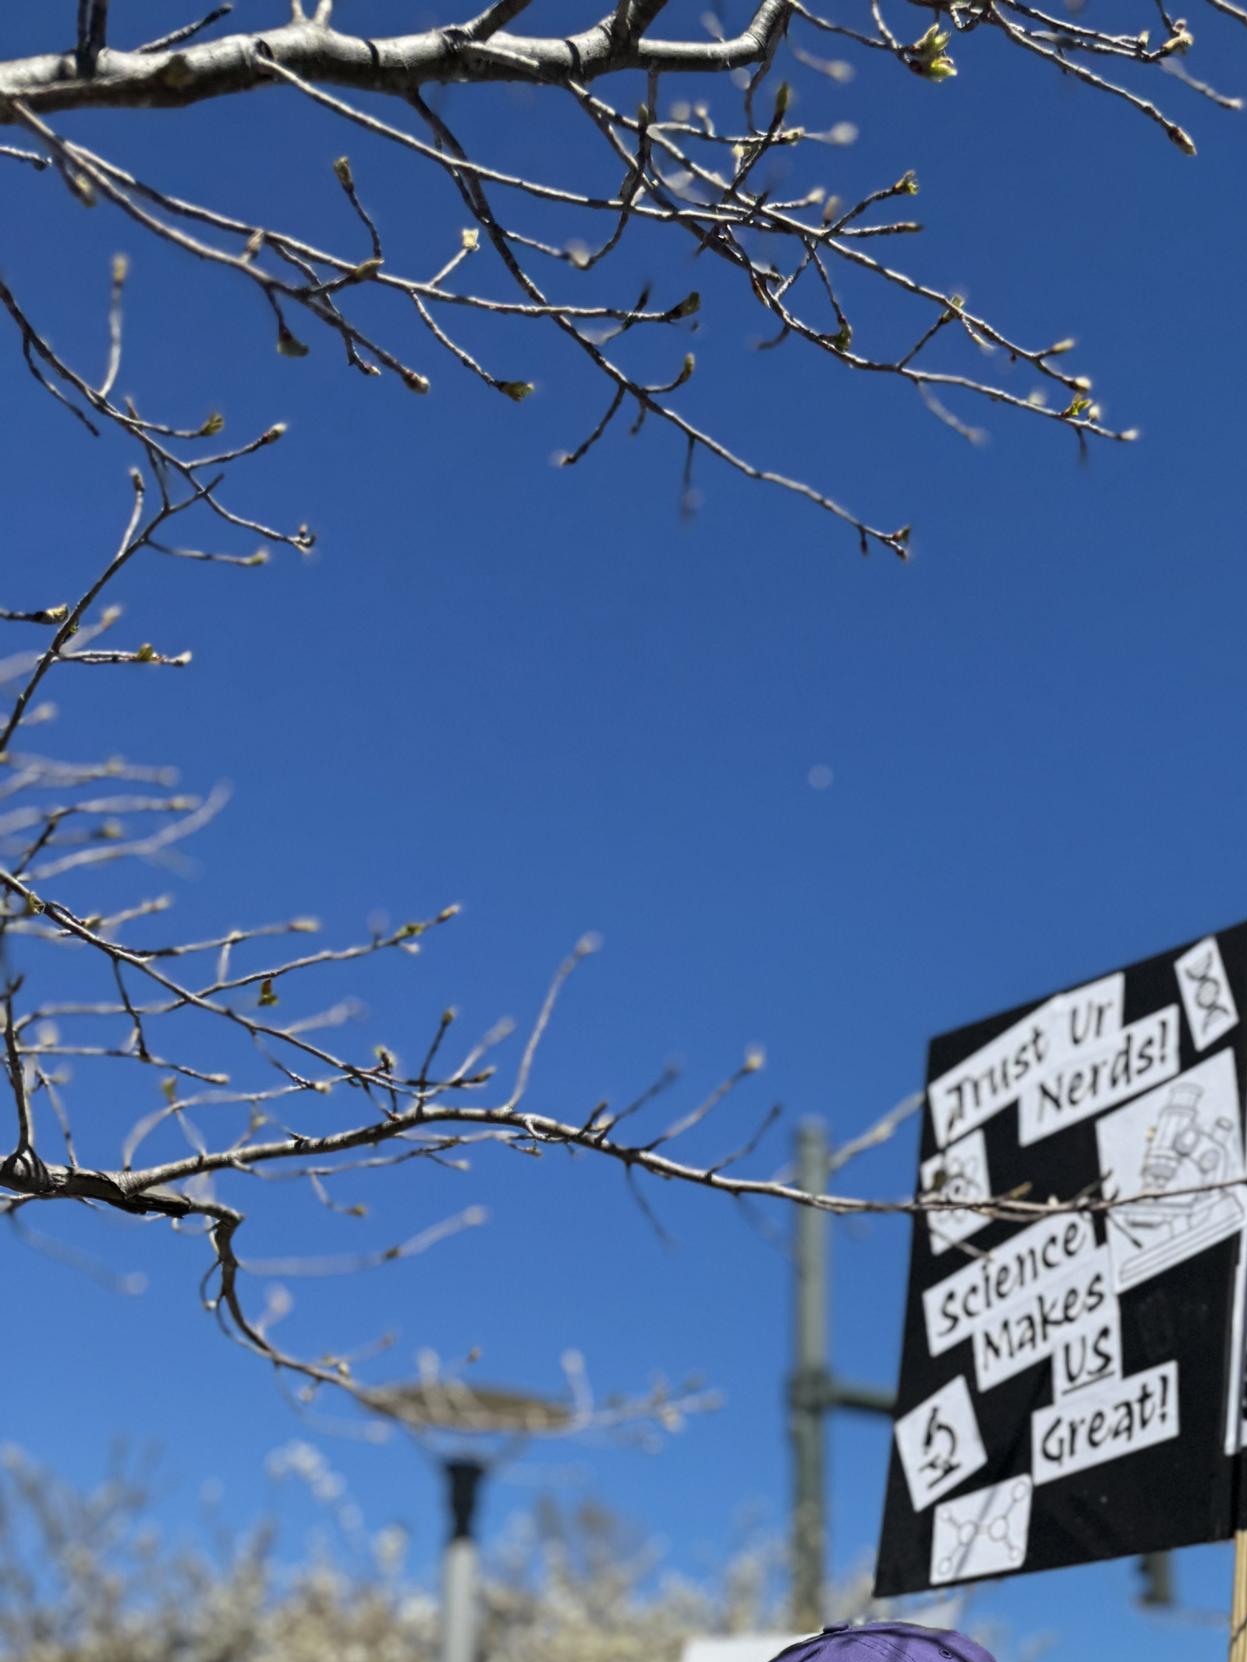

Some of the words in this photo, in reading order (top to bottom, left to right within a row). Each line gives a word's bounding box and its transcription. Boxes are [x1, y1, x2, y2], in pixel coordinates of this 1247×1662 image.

[946, 1026, 1049, 1119] Trust
[1070, 1000, 1113, 1045] Ur
[1037, 1019, 1169, 1123] Nerds!
[937, 1221, 1085, 1337] Science
[983, 1272, 1105, 1372] Makes
[1041, 1374, 1169, 1466] Great!
